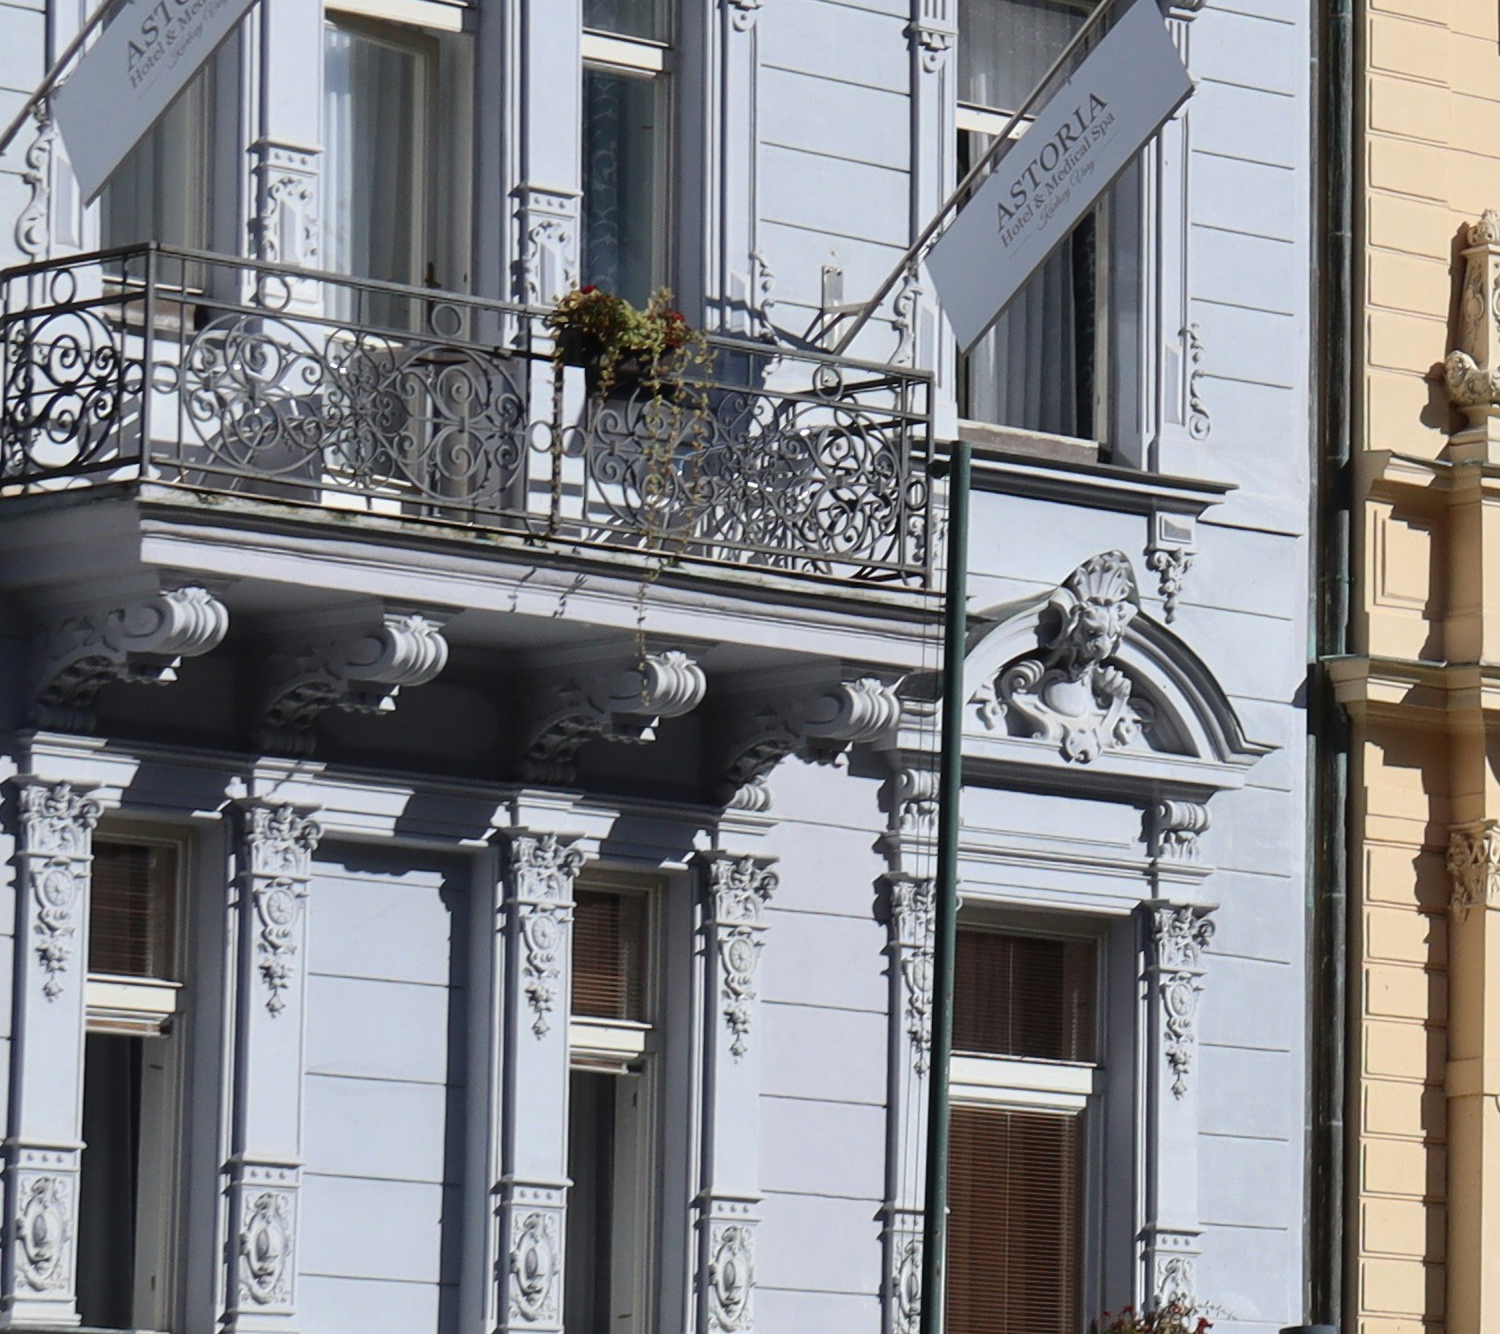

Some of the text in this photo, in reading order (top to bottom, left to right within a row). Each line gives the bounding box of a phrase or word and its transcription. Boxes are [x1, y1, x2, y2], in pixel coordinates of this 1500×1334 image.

[129, 42, 165, 89] Hotel
[163, 26, 178, 47] &
[996, 92, 1109, 233] ASTORIA
[1000, 112, 1116, 248] Hotel & Medical Spa
